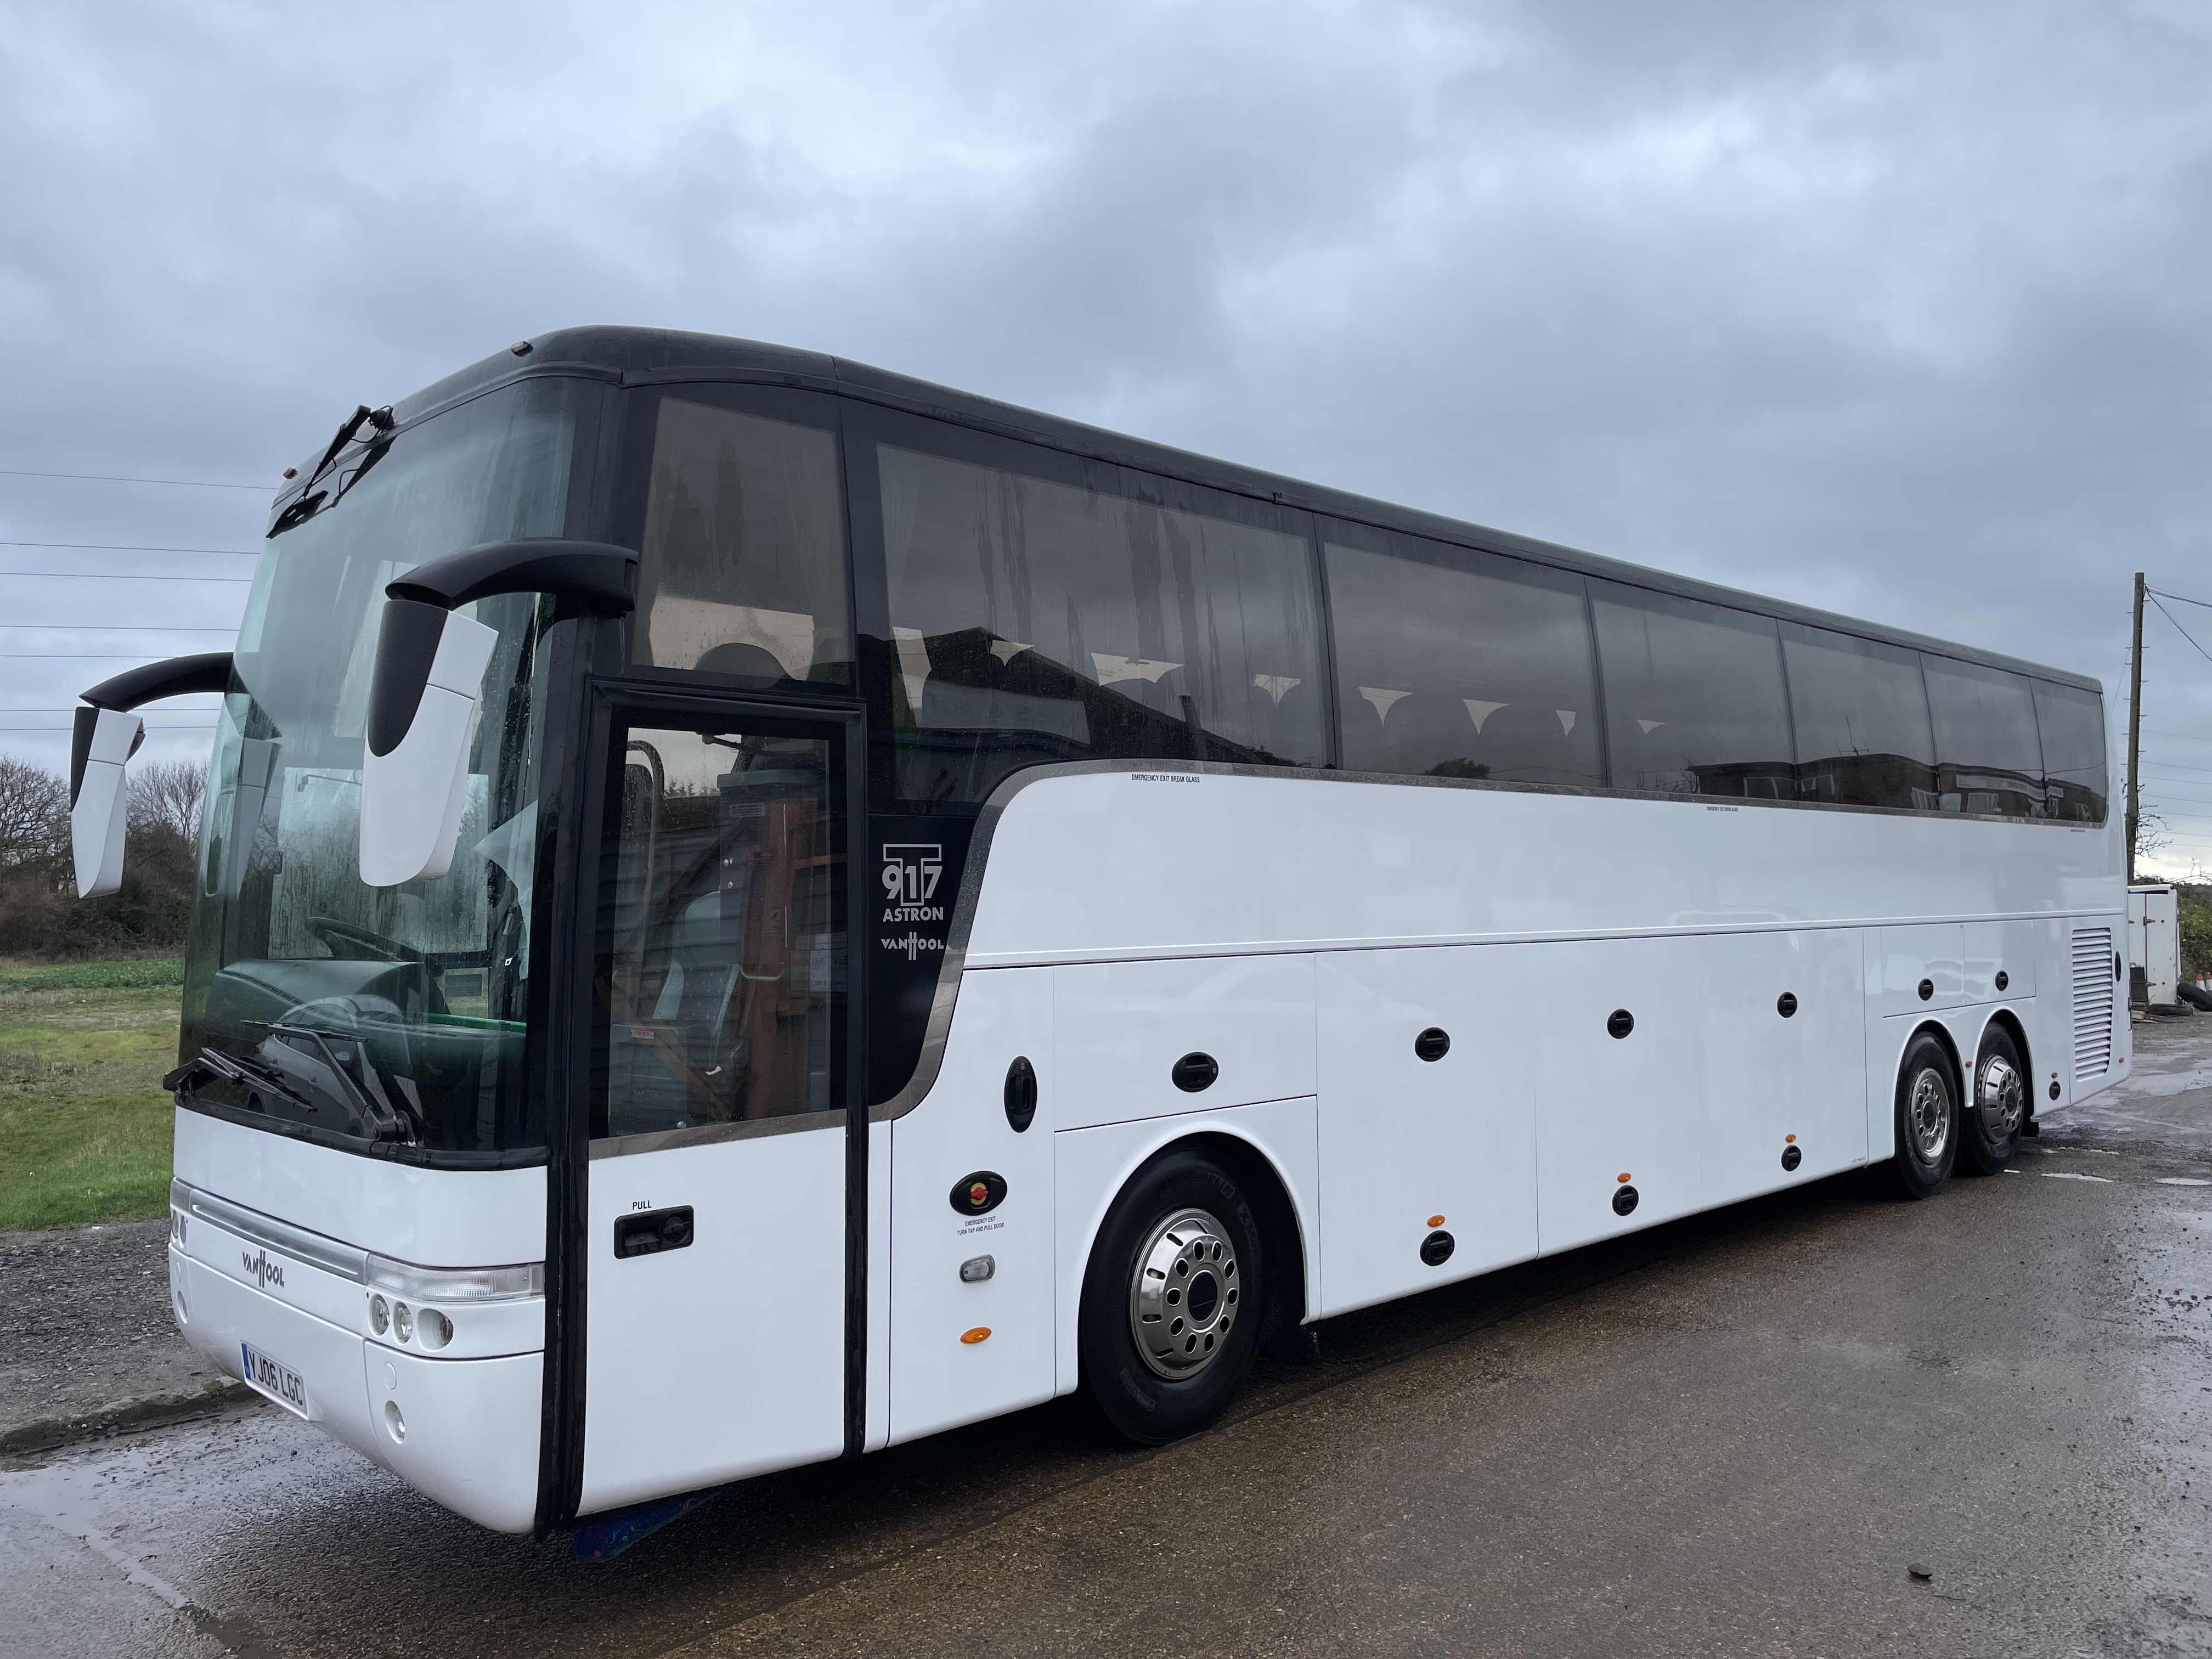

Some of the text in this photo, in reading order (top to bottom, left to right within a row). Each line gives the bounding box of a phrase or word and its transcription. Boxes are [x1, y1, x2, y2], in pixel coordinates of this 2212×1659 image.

[883, 907, 944, 922] ASTRON
[633, 1200, 652, 1210] PULL
[965, 1217, 988, 1226] EMERGENCY
[248, 1350, 303, 1406] YJ06 LGC
